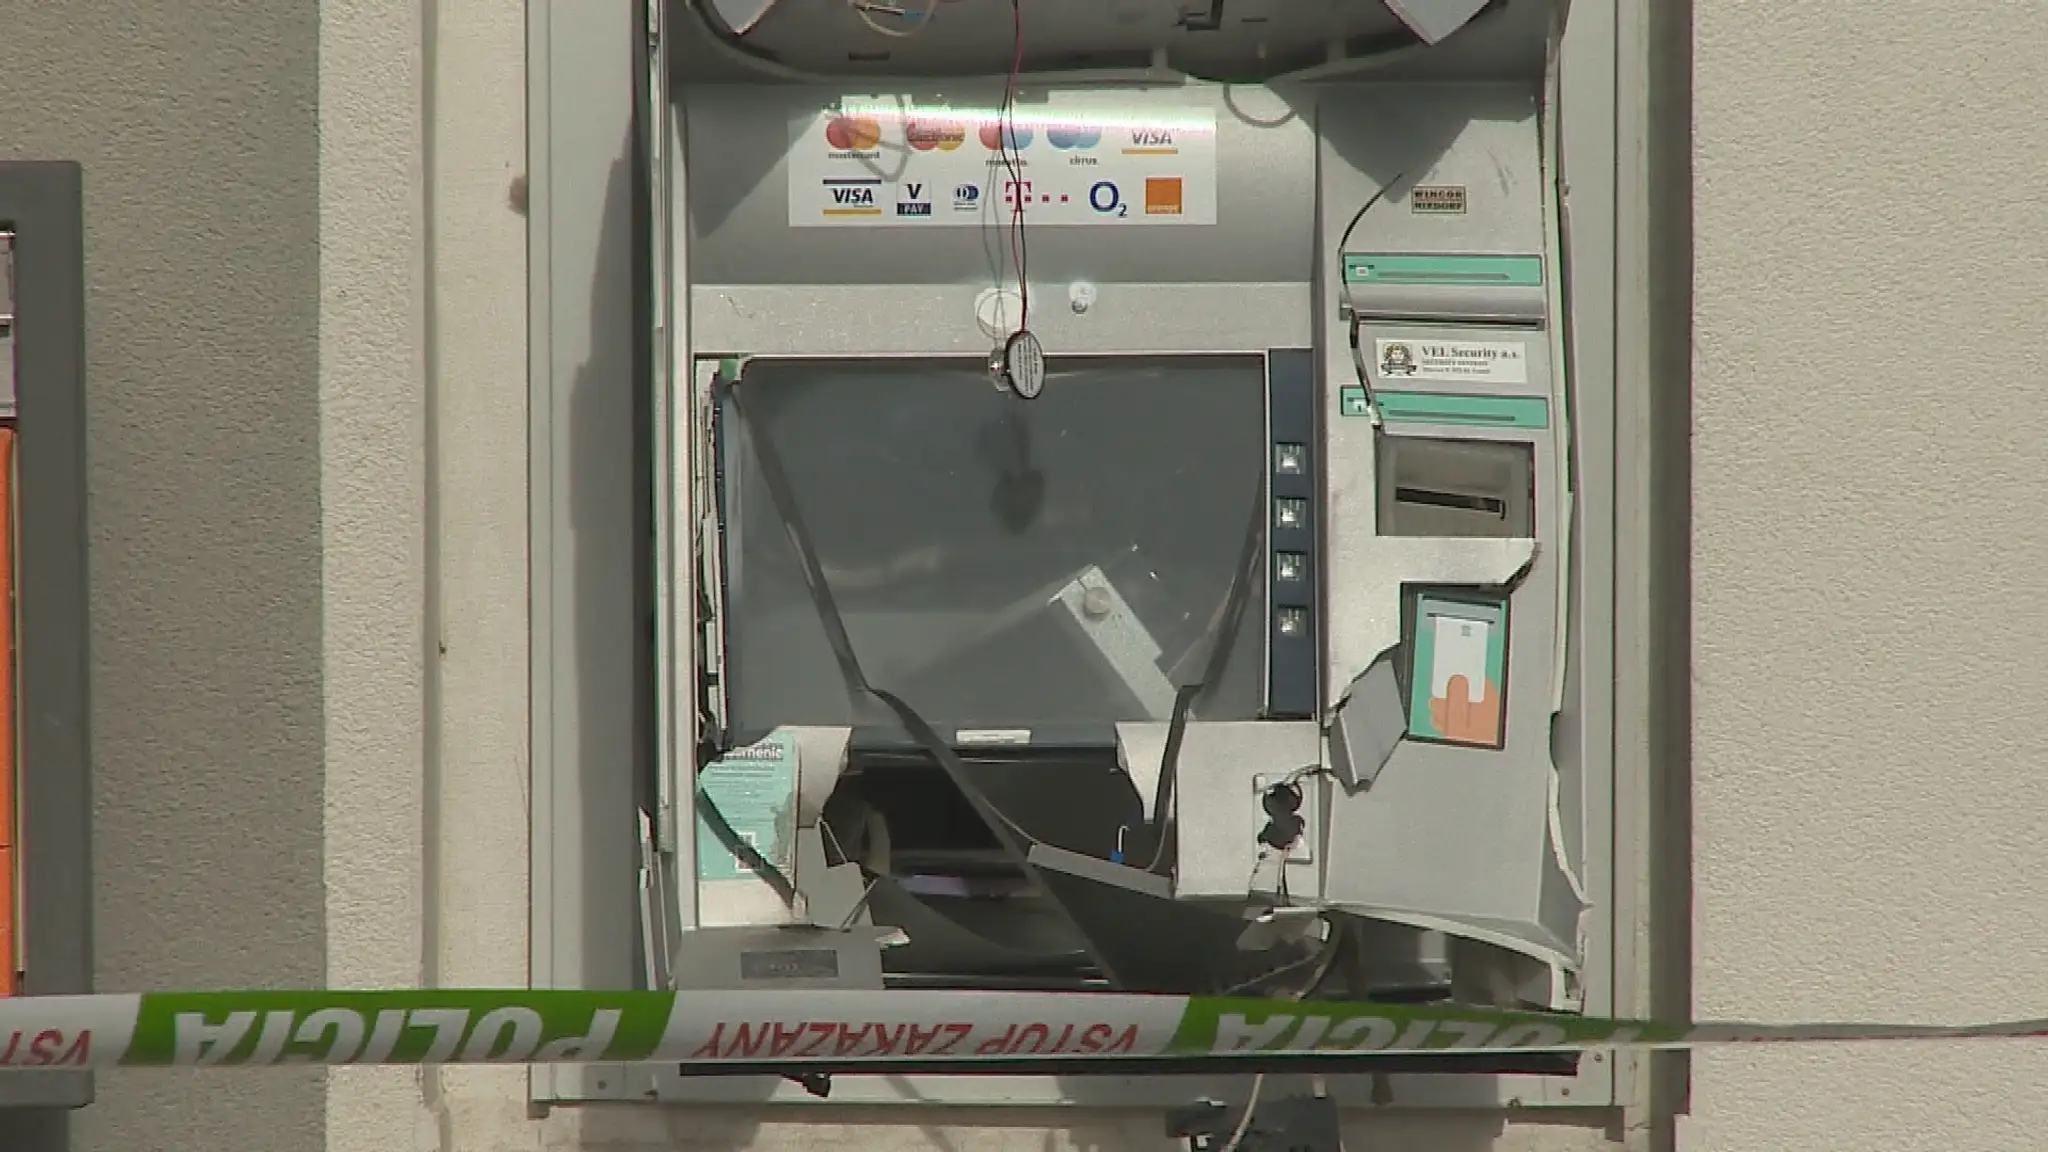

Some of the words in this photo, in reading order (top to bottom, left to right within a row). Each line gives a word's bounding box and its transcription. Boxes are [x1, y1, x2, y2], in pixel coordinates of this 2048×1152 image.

[1132, 129, 1172, 144] VISA
[832, 188, 874, 204] VISA
[907, 184, 922, 199] V
[904, 205, 925, 214] PAY
[1451, 347, 1497, 360] Security
[980, 1023, 1140, 1057] VSTUP
